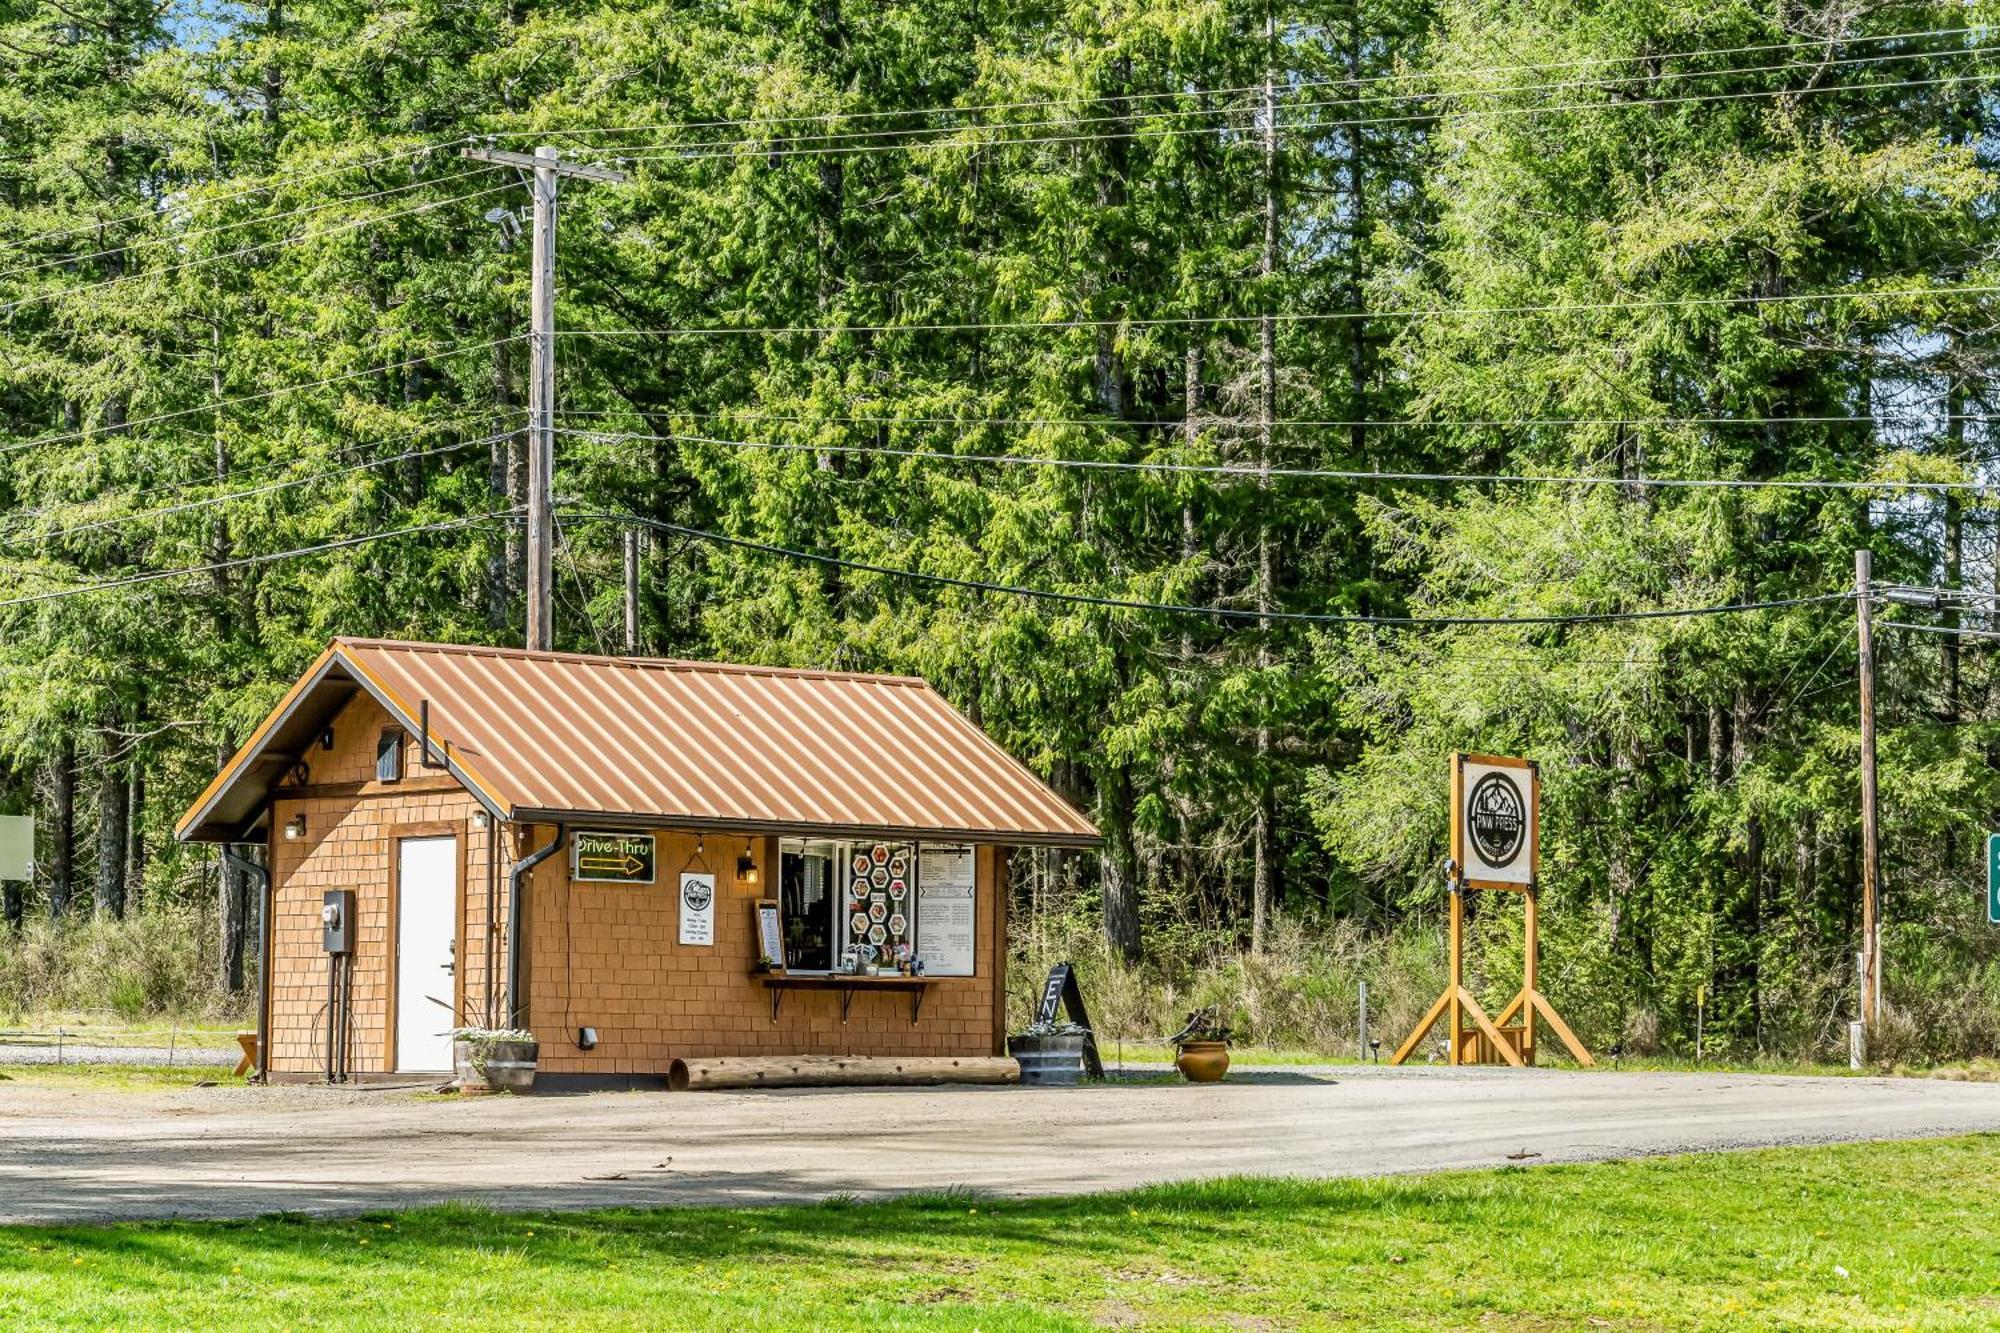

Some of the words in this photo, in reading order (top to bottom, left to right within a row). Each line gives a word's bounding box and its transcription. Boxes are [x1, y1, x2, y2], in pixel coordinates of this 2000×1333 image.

[1477, 815, 1493, 829] PNW
[1495, 816, 1517, 831] PRESS
[578, 837, 648, 855] Drive-Thru
